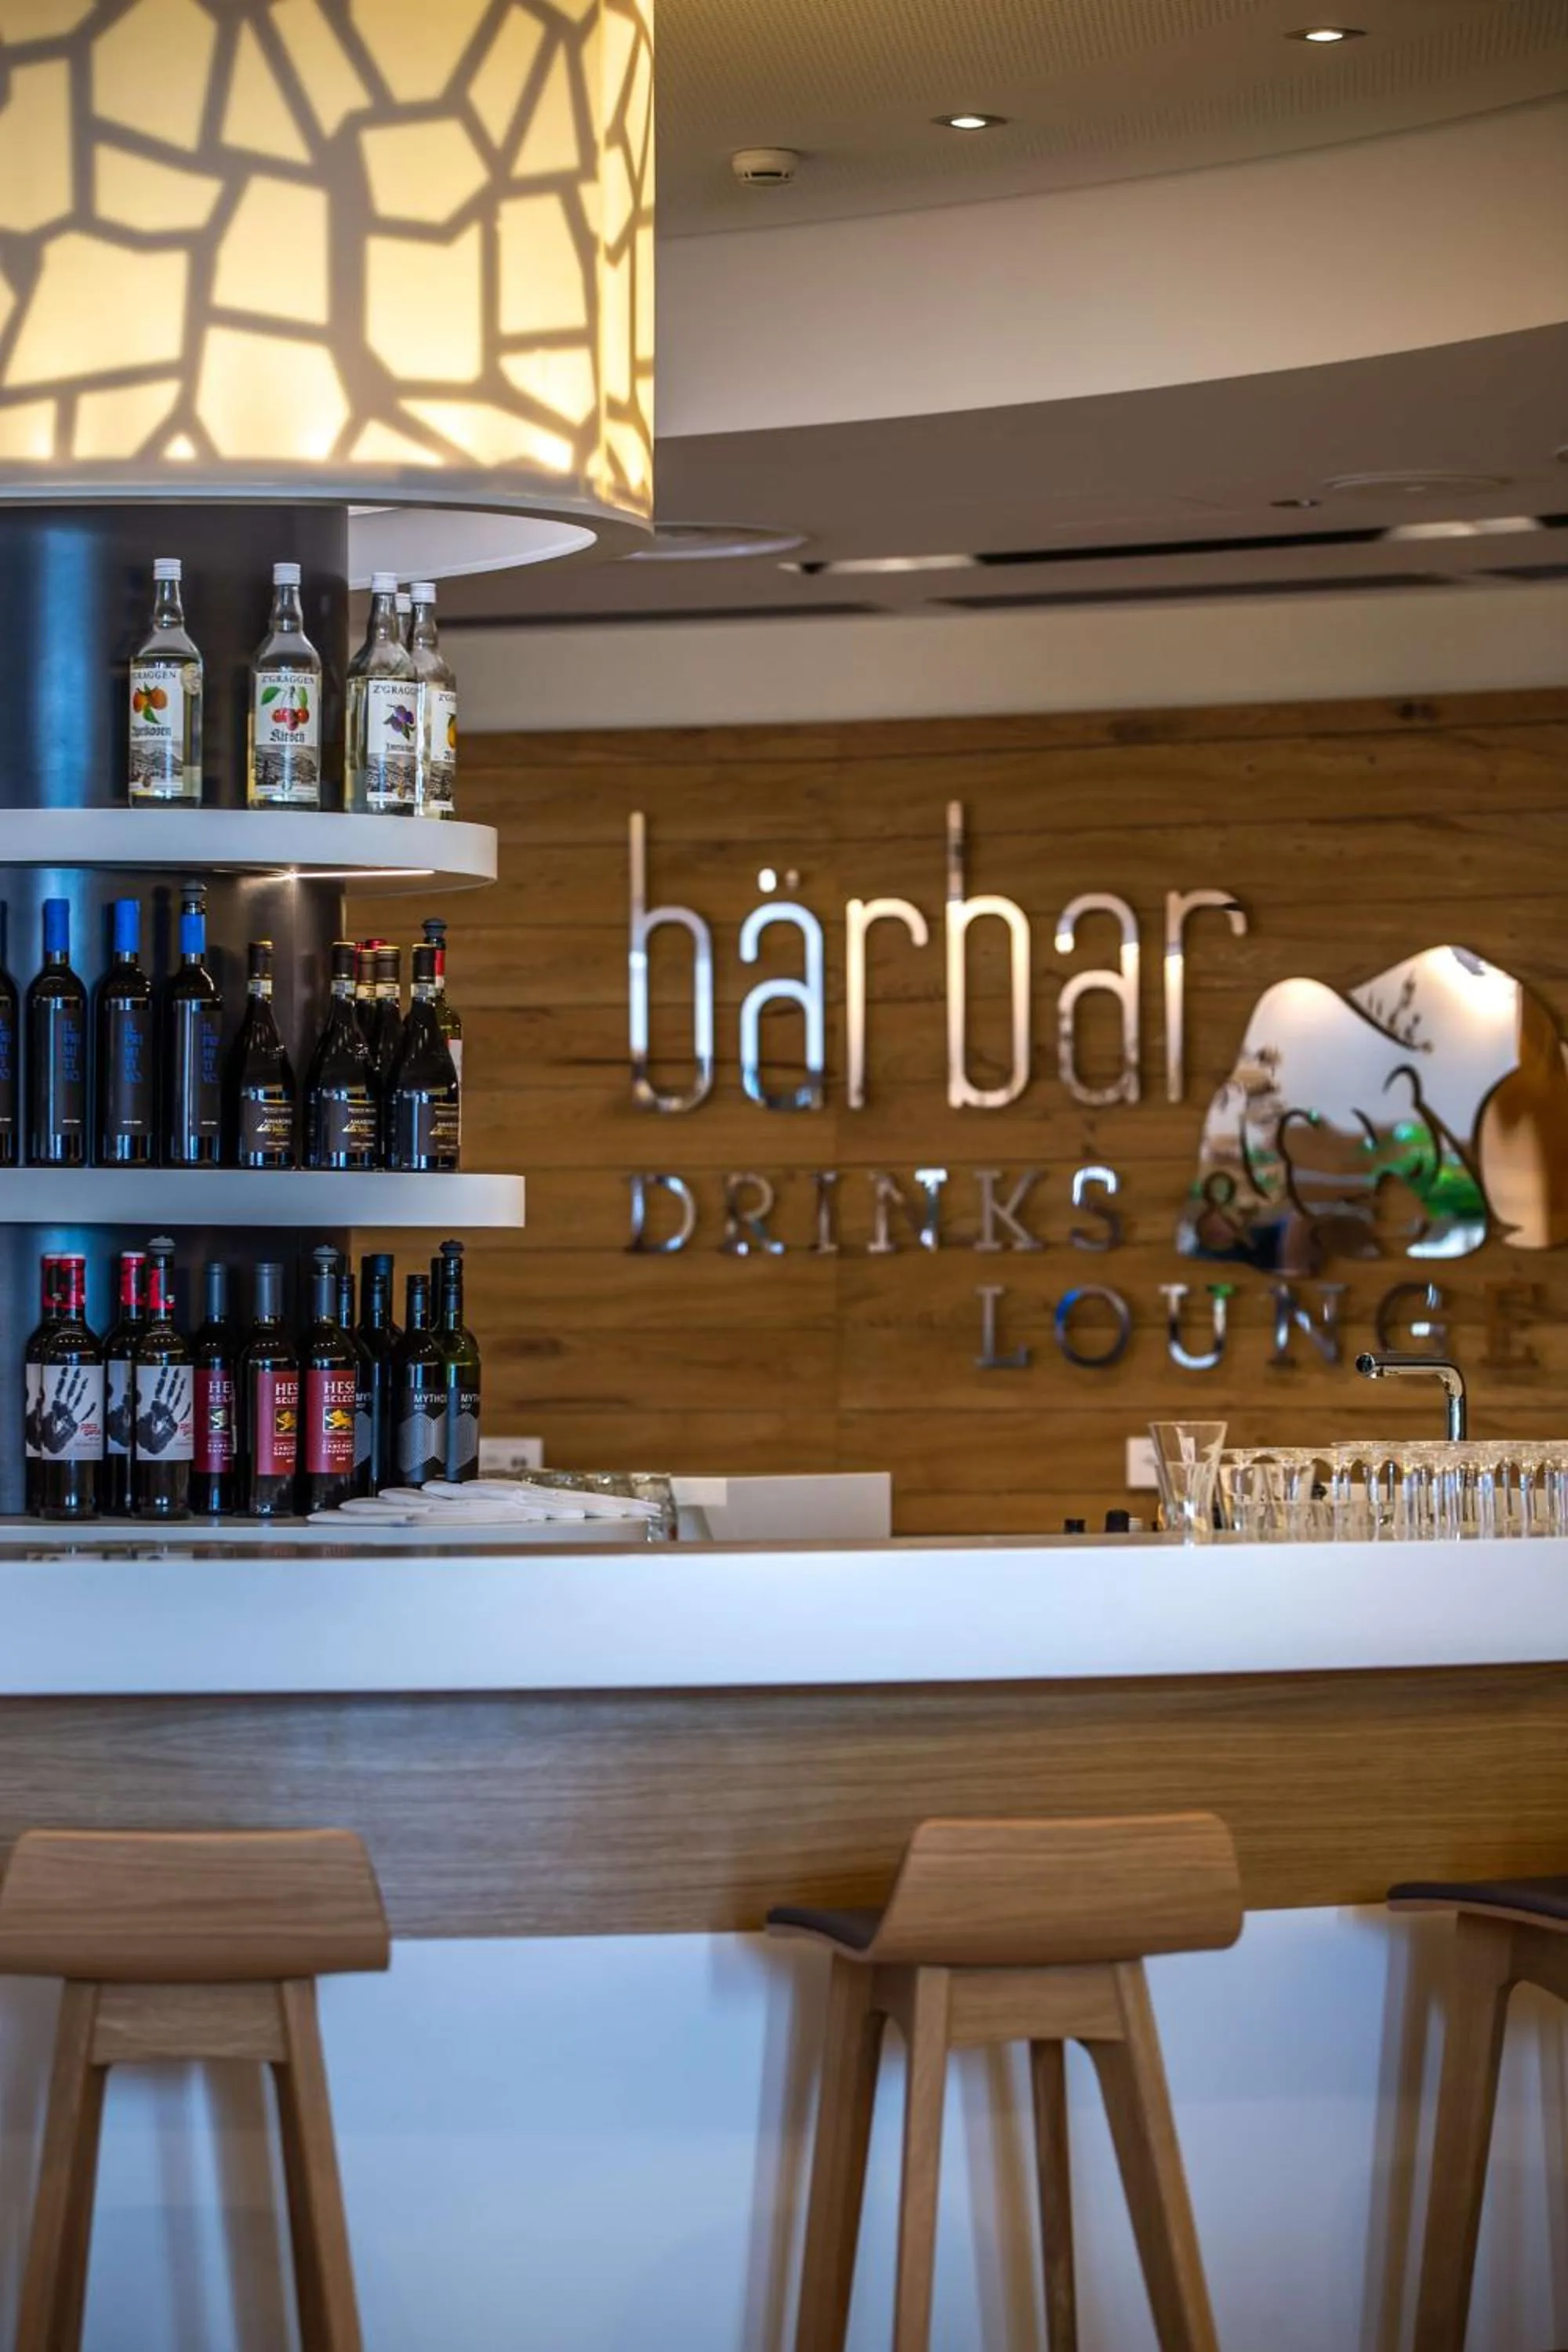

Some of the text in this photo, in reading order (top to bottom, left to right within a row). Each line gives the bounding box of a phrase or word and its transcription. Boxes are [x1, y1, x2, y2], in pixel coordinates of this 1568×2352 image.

[269, 728, 305, 744] Kirsch
[630, 800, 1247, 1112] bärbar
[625, 1167, 1122, 1254] DRINKS
[975, 1281, 1541, 1370] LOUNGE
[209, 1381, 234, 1393] HE
[413, 1394, 448, 1403] MYTHO
